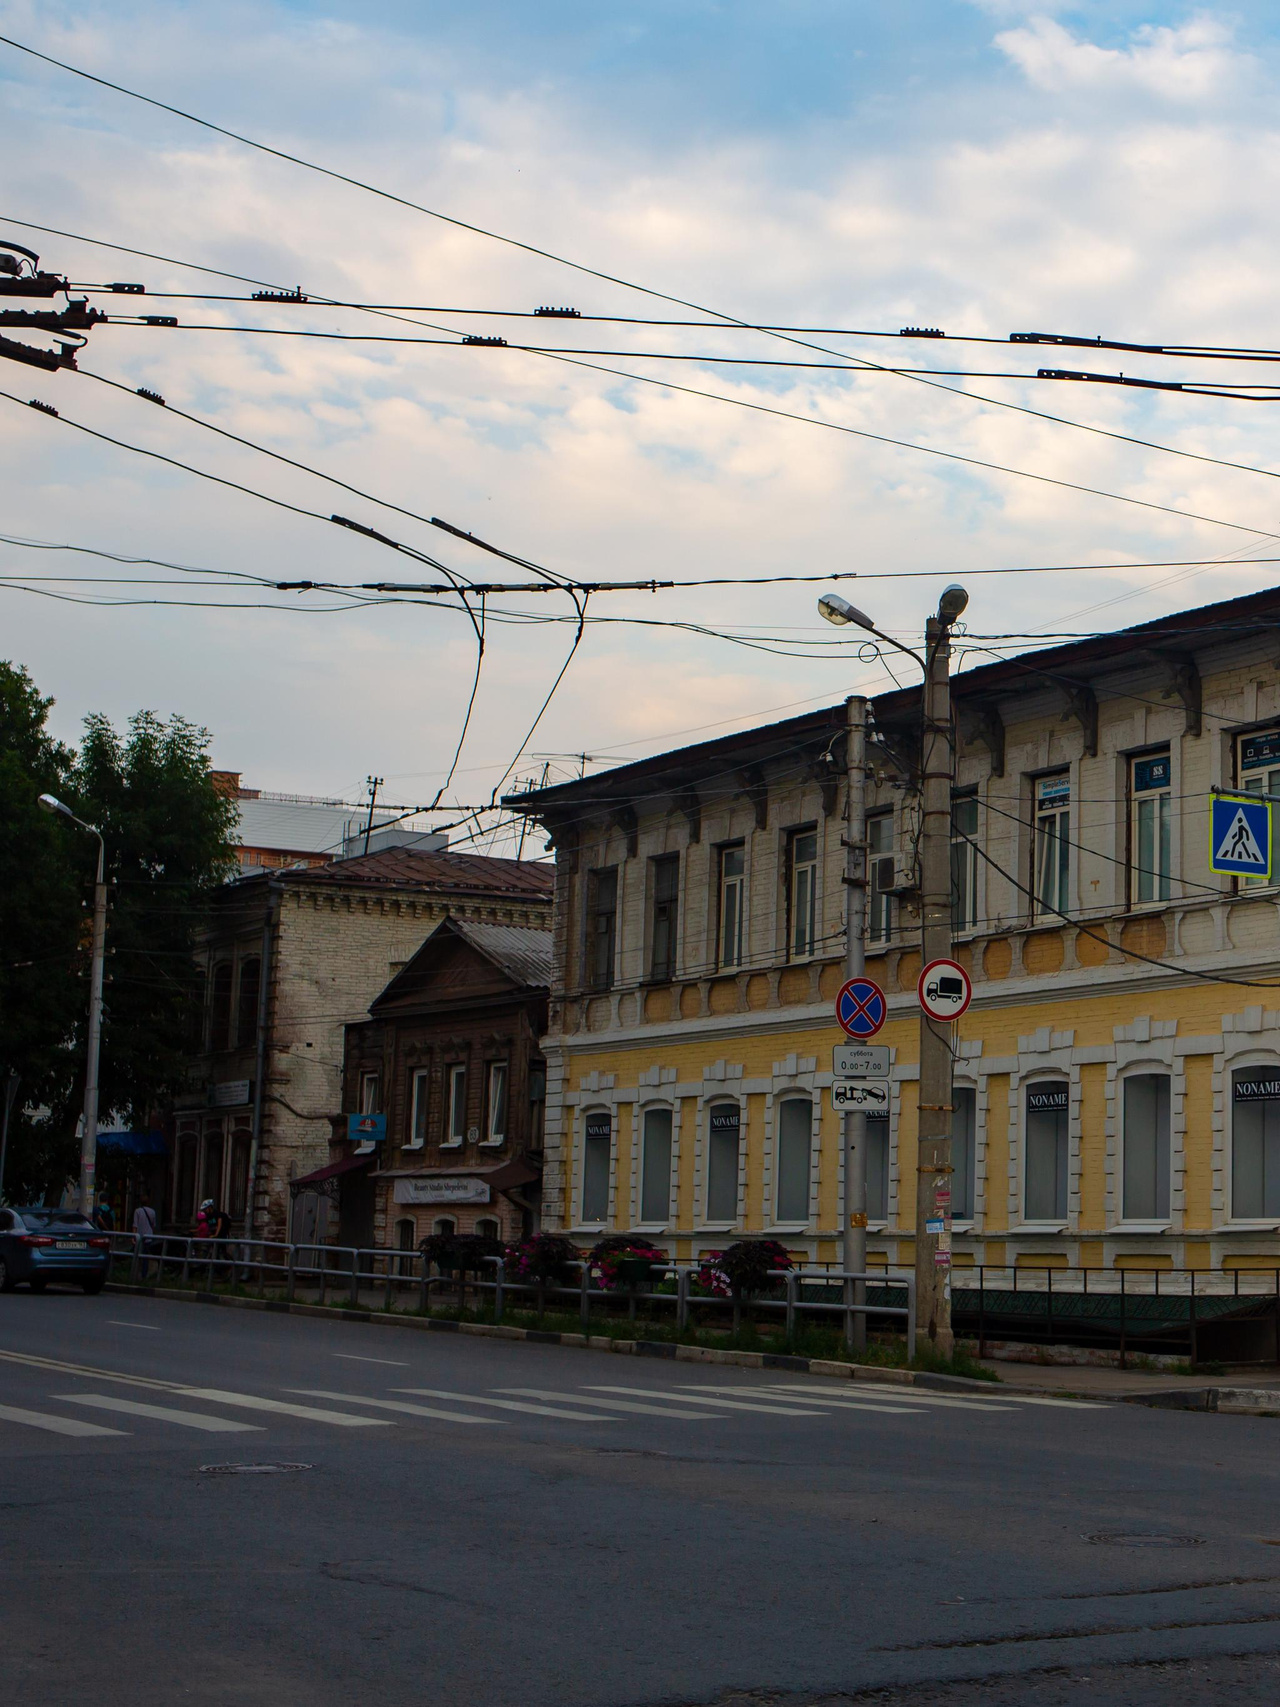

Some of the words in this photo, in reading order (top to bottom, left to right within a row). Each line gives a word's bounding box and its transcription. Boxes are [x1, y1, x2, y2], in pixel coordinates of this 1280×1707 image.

[850, 1050, 873, 1058] суббота
[841, 1061, 882, 1070] 0.00-7.00
[1236, 1081, 1280, 1095] NONAME
[1030, 1093, 1067, 1106] NONAME
[712, 1115, 739, 1127] NONAME
[588, 1125, 610, 1135] NONAME
